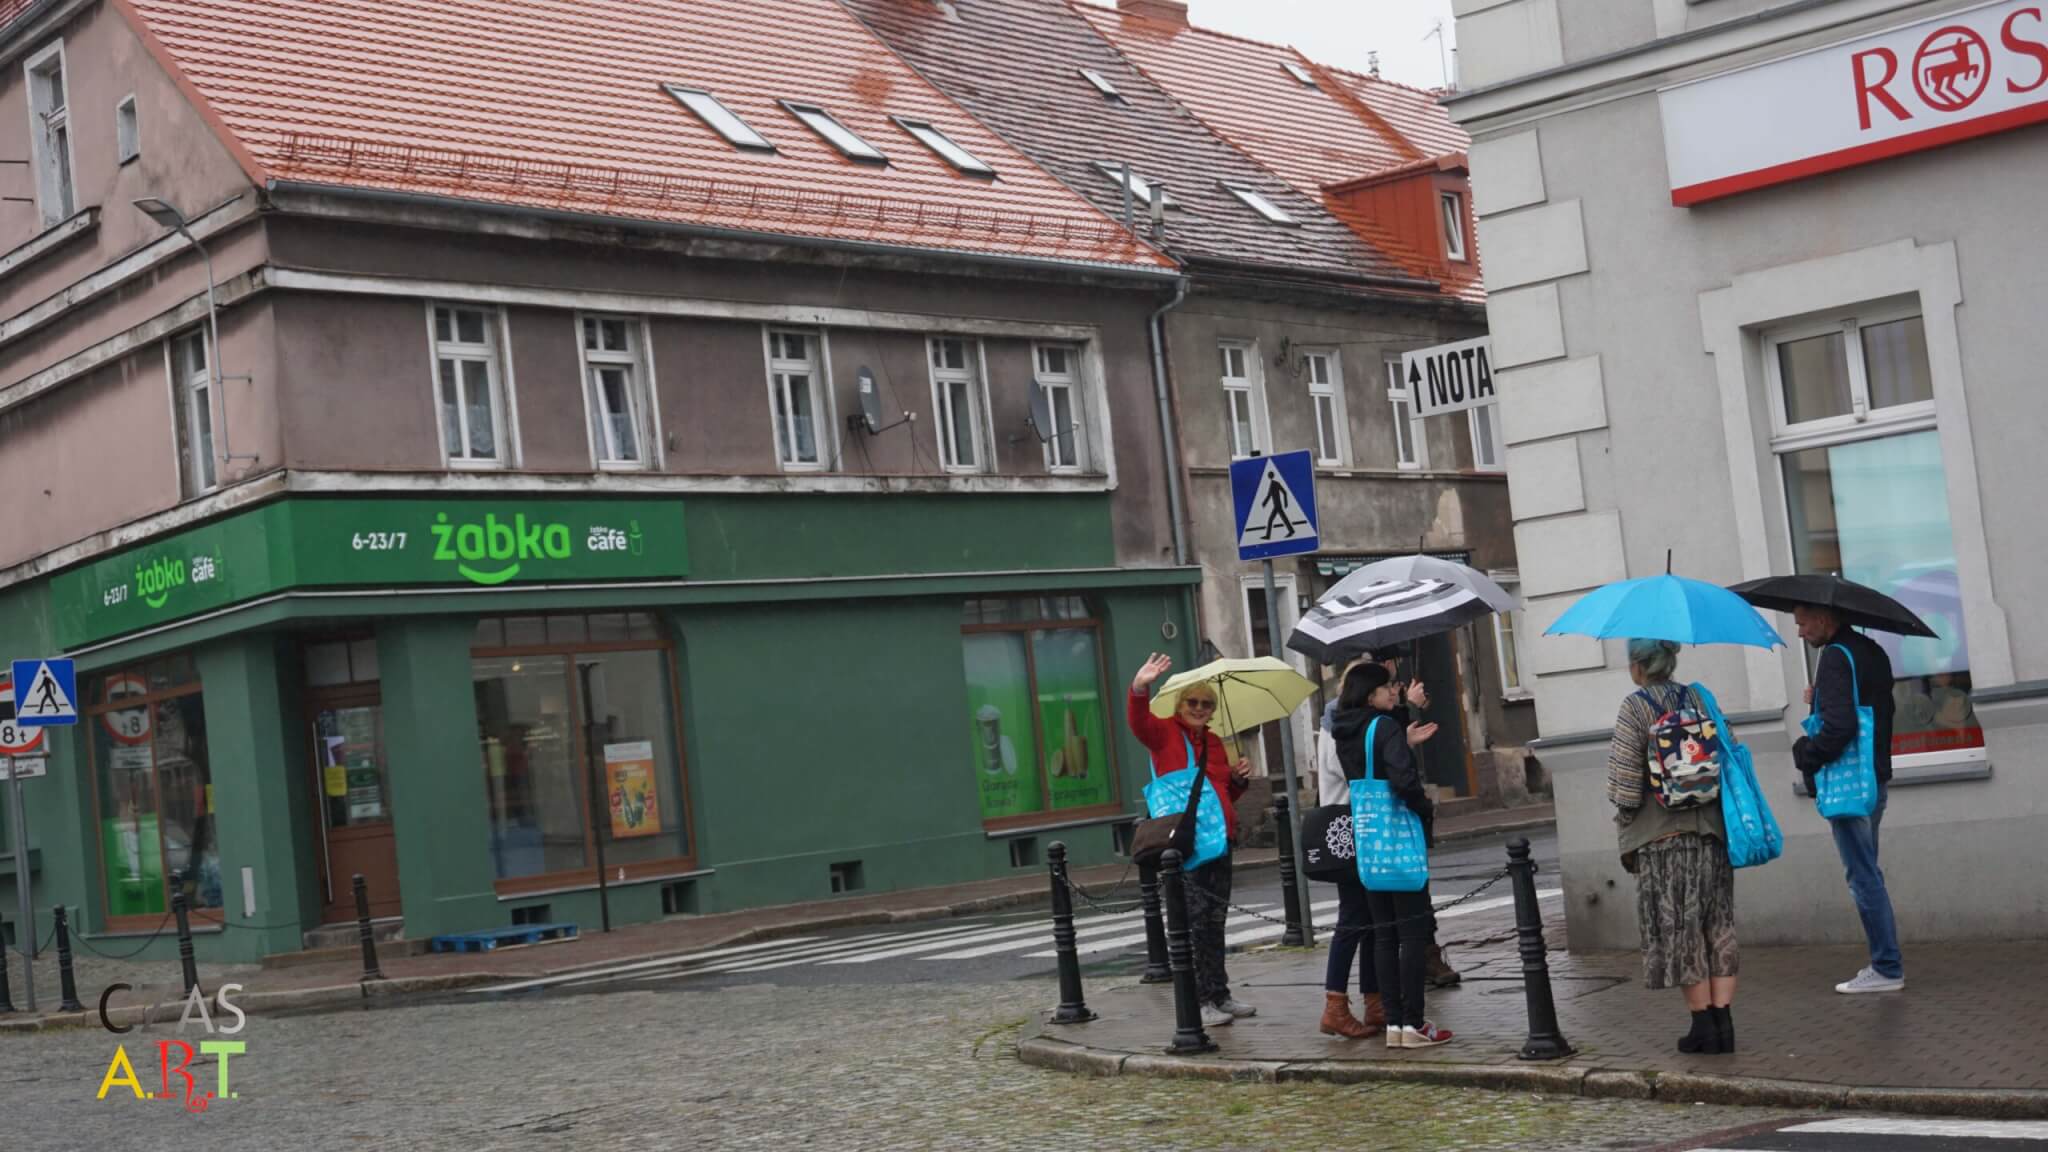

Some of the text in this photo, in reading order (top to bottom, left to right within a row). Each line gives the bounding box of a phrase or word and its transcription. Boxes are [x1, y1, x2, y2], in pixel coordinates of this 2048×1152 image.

[1426, 346, 1494, 406] NOTA
[352, 532, 407, 550] 6-23/7
[431, 512, 571, 560] żabka
[136, 555, 185, 596] żabka
[2, 726, 26, 744] 8 t
